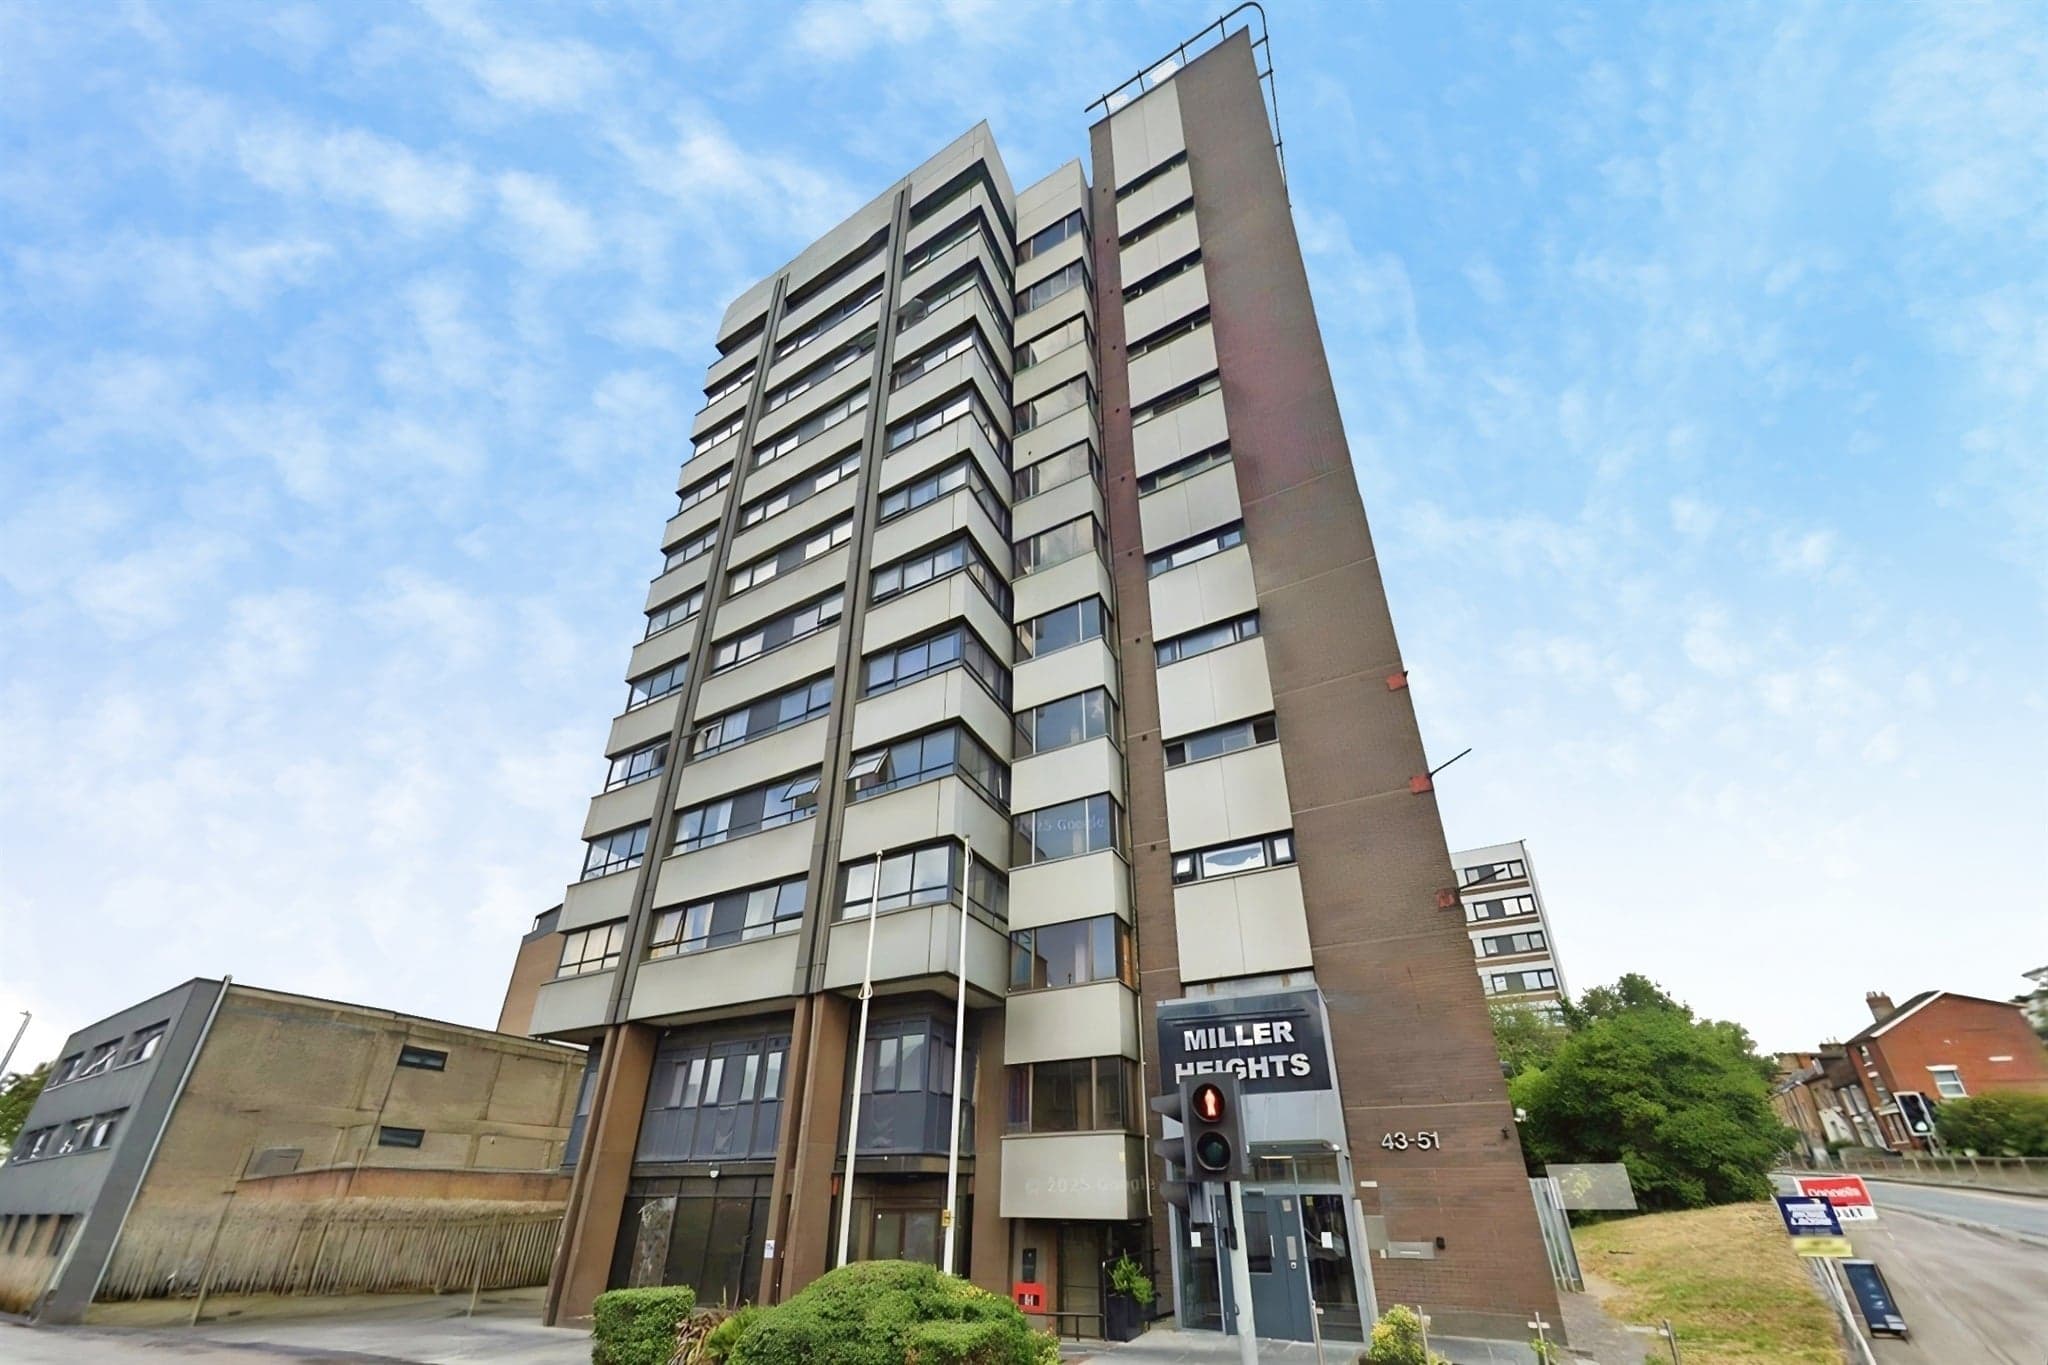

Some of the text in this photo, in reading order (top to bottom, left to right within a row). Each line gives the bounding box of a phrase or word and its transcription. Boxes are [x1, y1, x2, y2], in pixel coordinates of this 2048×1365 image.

[1184, 1021, 1295, 1051] MILLER
[1175, 1053, 1311, 1084] HEIGHTS
[1381, 1131, 1440, 1150] 43-51
